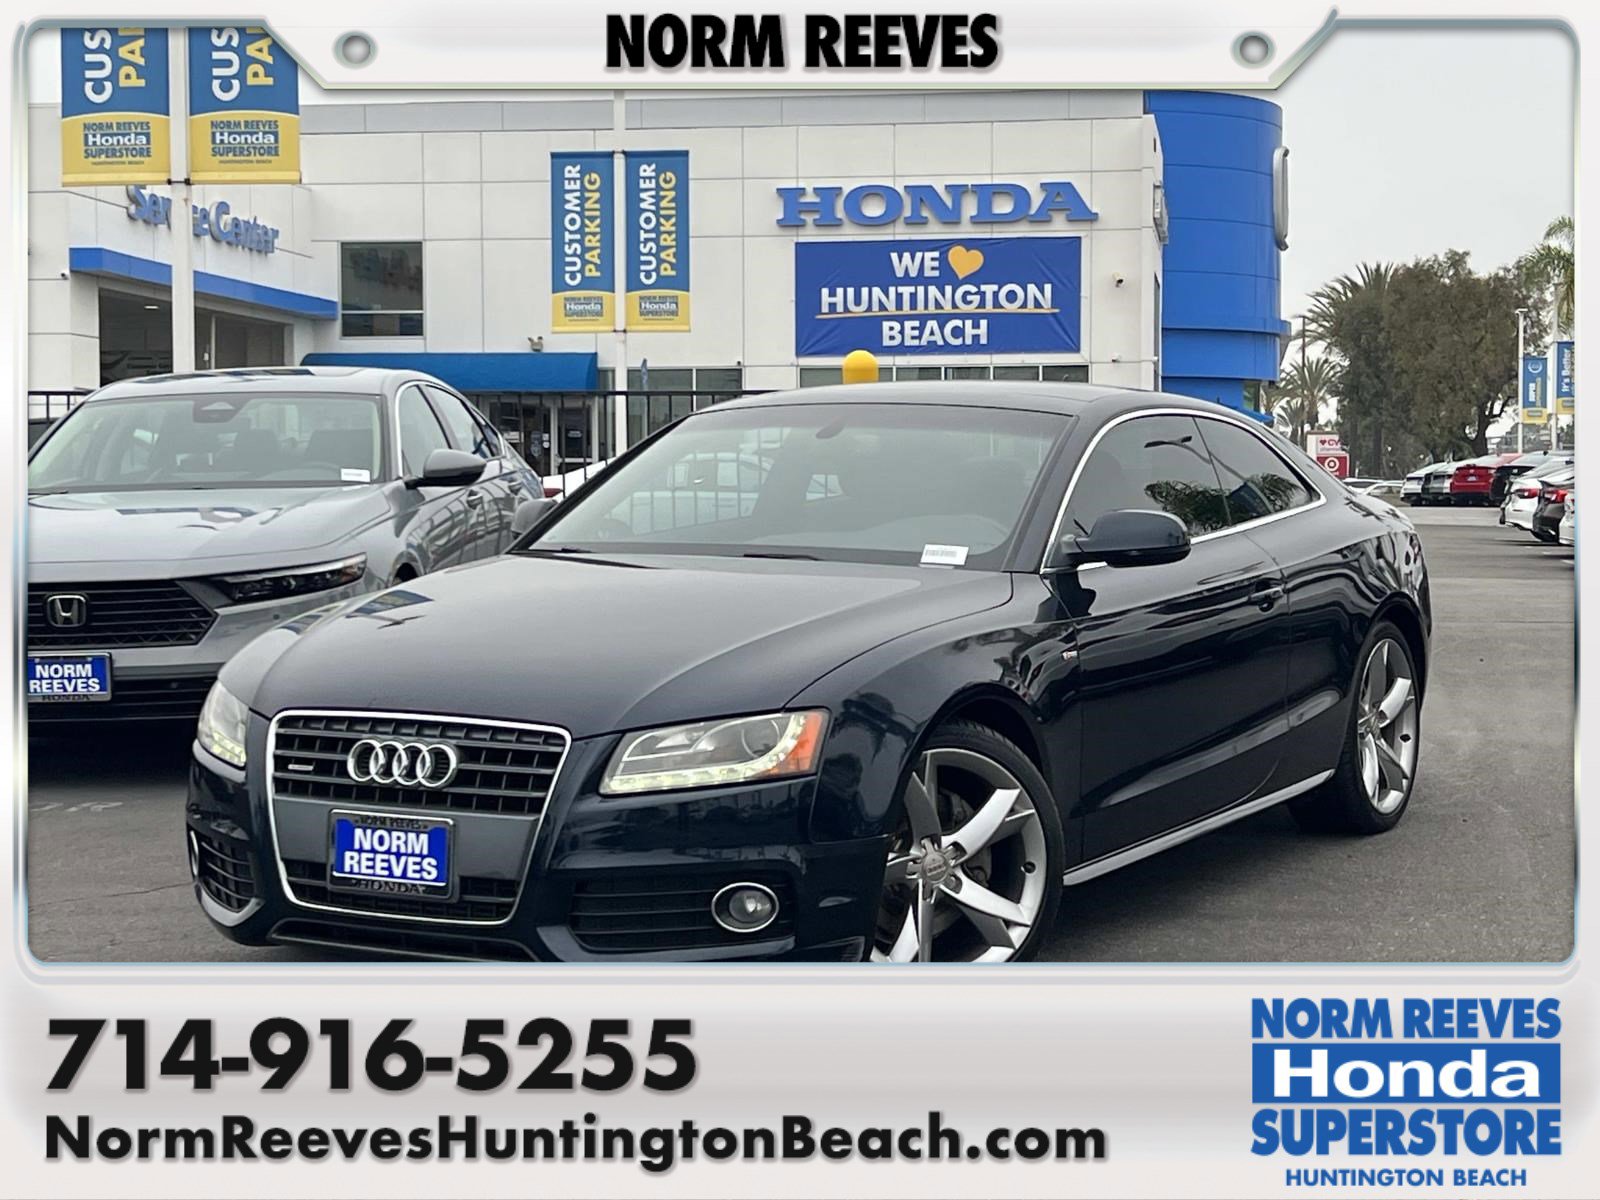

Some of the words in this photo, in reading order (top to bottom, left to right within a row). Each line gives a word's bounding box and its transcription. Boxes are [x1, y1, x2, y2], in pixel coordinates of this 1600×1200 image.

[83, 121, 114, 132] NORM
[116, 121, 151, 131] REEVES
[211, 120, 241, 130] NORM
[244, 120, 279, 130] REEVES
[215, 132, 275, 144] Honda
[88, 133, 147, 146] Honda
[211, 146, 280, 157] SUPERSTORE
[84, 147, 152, 159] SUPERSTORE
[776, 182, 1099, 226] HONDA
[208, 201, 280, 255] Center
[564, 164, 582, 286] CUSTOMER
[583, 172, 601, 277] PARKING
[639, 163, 657, 285] CUSTOMER
[659, 171, 676, 276] PARKING
[890, 252, 940, 278] WE
[566, 302, 602, 311] Honda
[641, 301, 677, 310] Honda
[820, 283, 1053, 313] HUNTINGTON
[881, 319, 988, 347] BEACH
[35, 664, 92, 678] NORM
[29, 678, 100, 693] REEVES
[354, 828, 429, 855] NORM
[343, 850, 438, 881] REEVES
